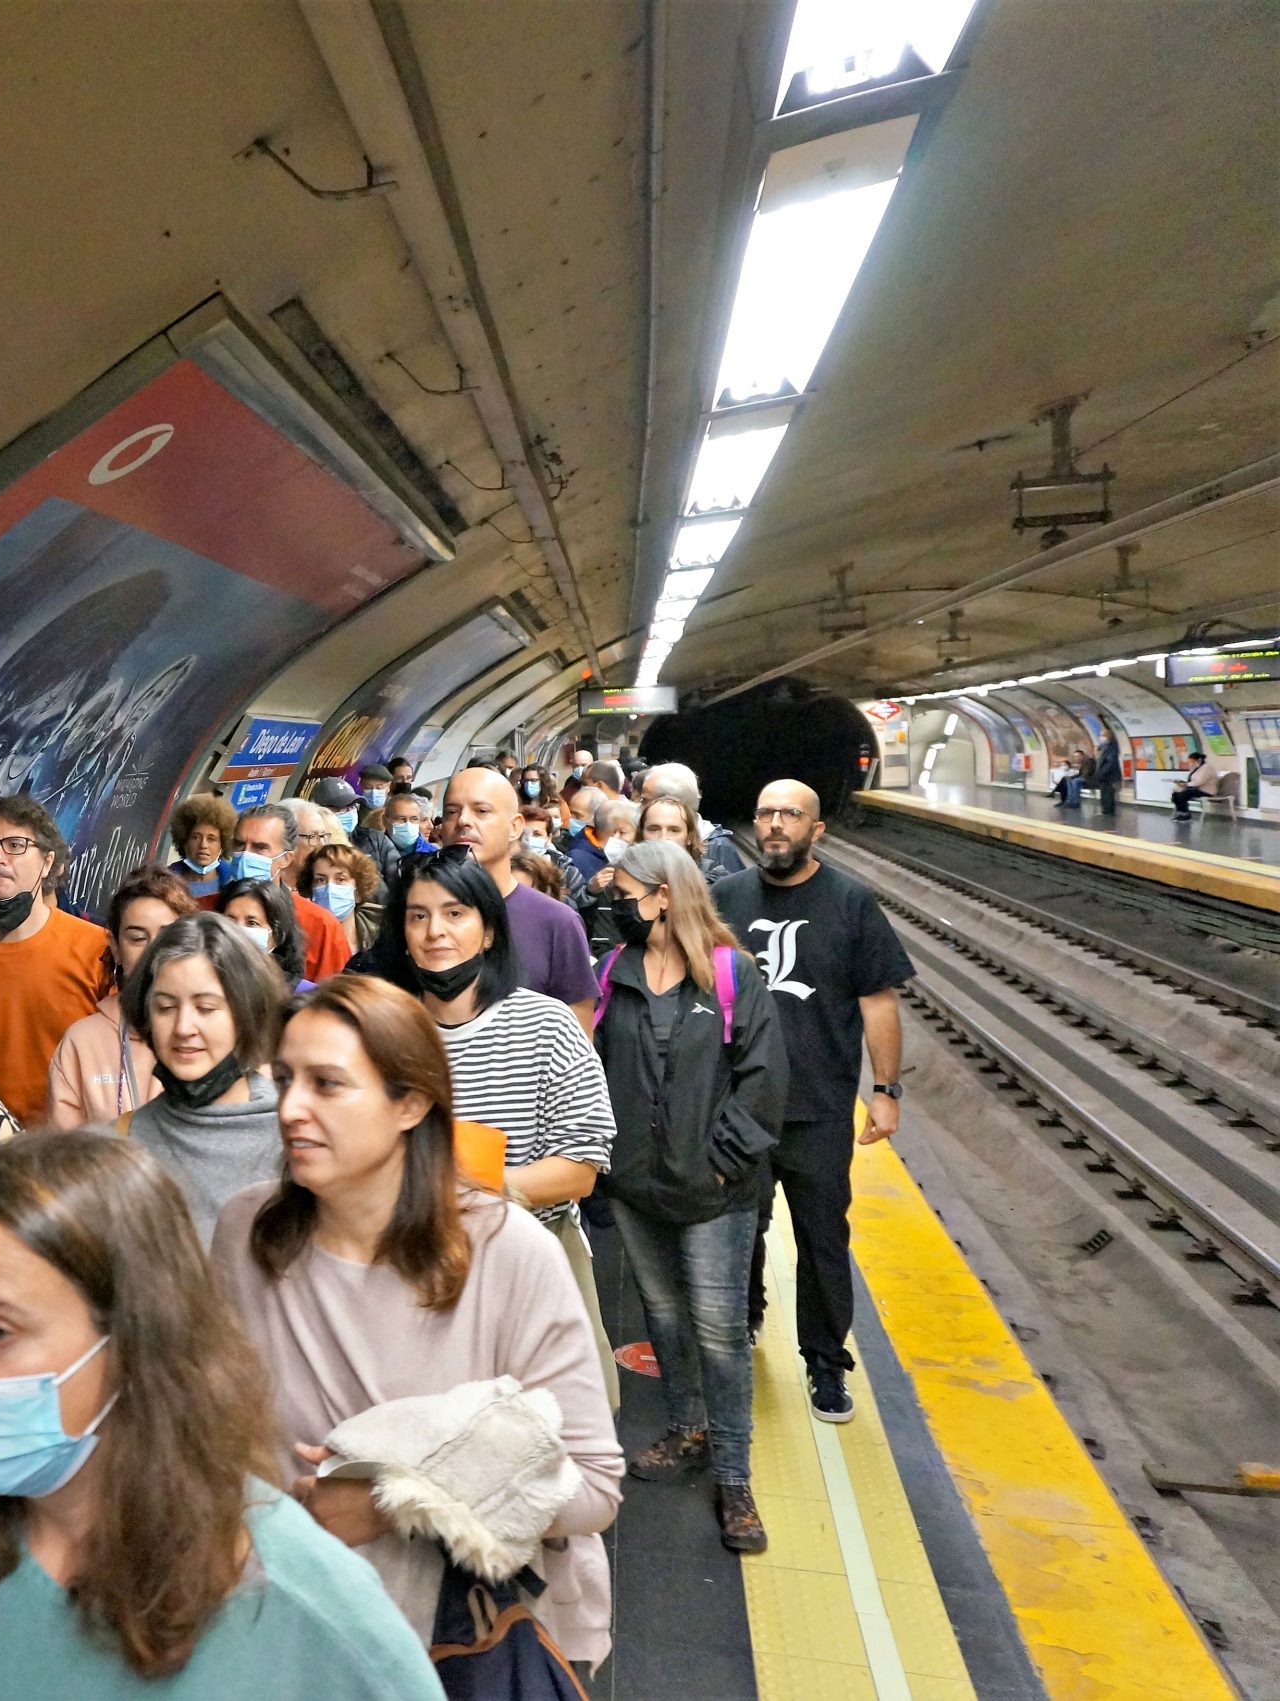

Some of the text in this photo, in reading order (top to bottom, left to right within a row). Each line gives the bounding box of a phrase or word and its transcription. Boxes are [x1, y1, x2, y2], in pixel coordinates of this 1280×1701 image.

[249, 729, 279, 760] Diego
[272, 730, 289, 753] de
[283, 730, 305, 753] León
[748, 918, 817, 1000] L
